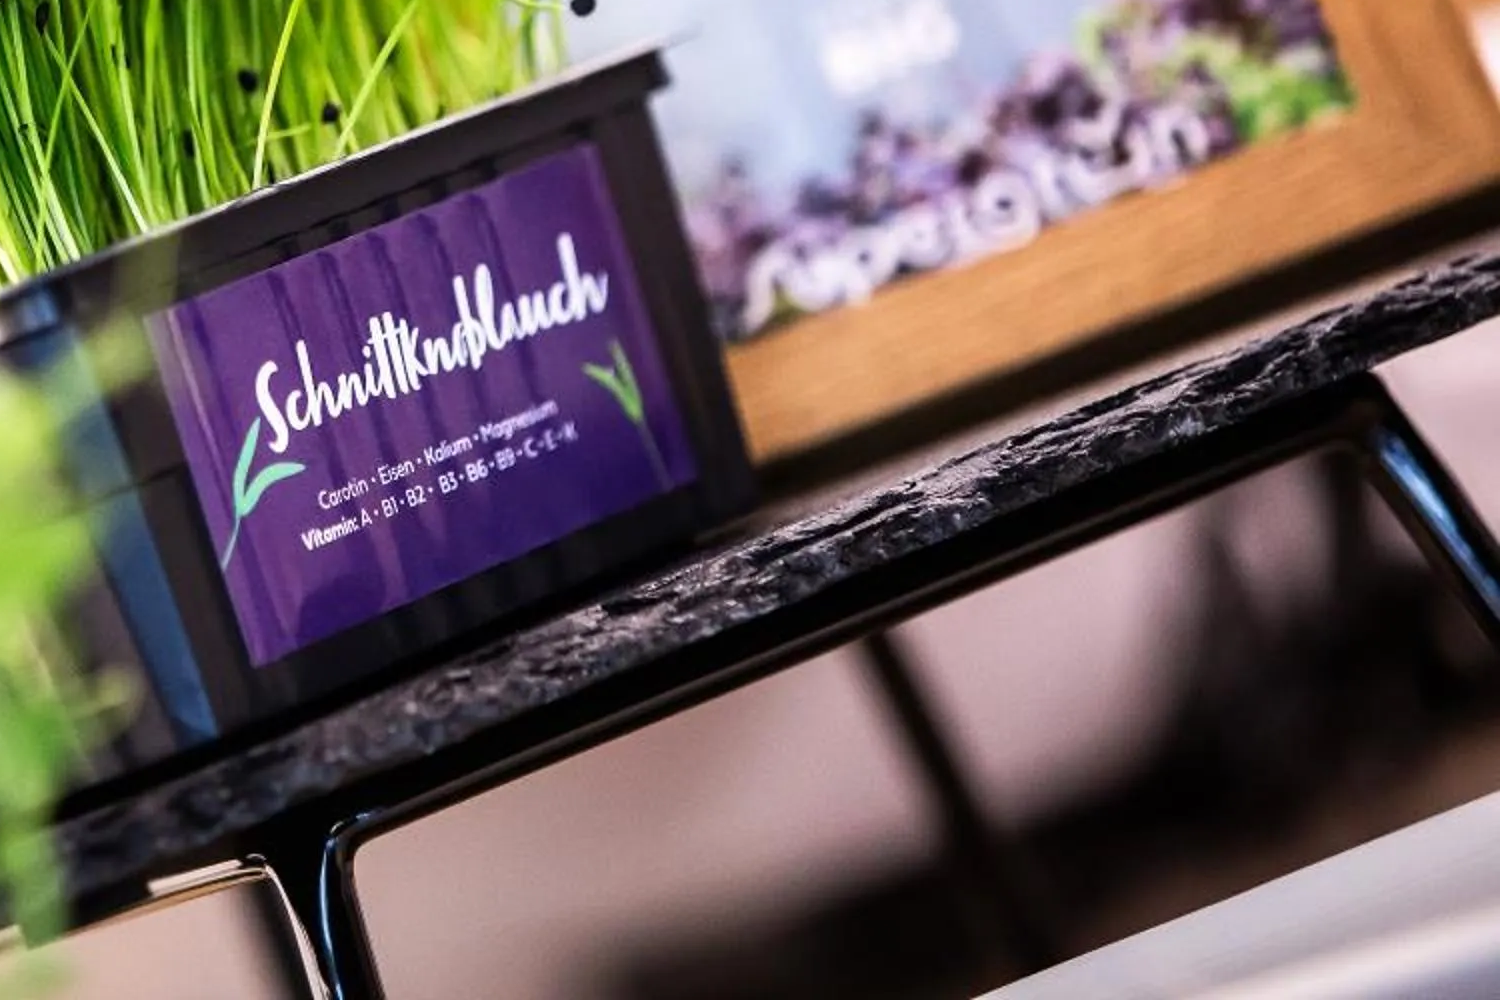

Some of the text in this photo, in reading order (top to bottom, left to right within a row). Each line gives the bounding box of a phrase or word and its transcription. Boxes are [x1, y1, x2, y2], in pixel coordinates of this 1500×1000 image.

[301, 516, 359, 551] Vitamin:
[361, 508, 373, 527] A
[381, 496, 399, 518] B1
[405, 485, 427, 508] B2
[438, 471, 459, 494] B3
[465, 458, 489, 482] B6
[523, 437, 539, 459] C
[318, 400, 559, 510] Carotin Eisen Kalium Magnesium
